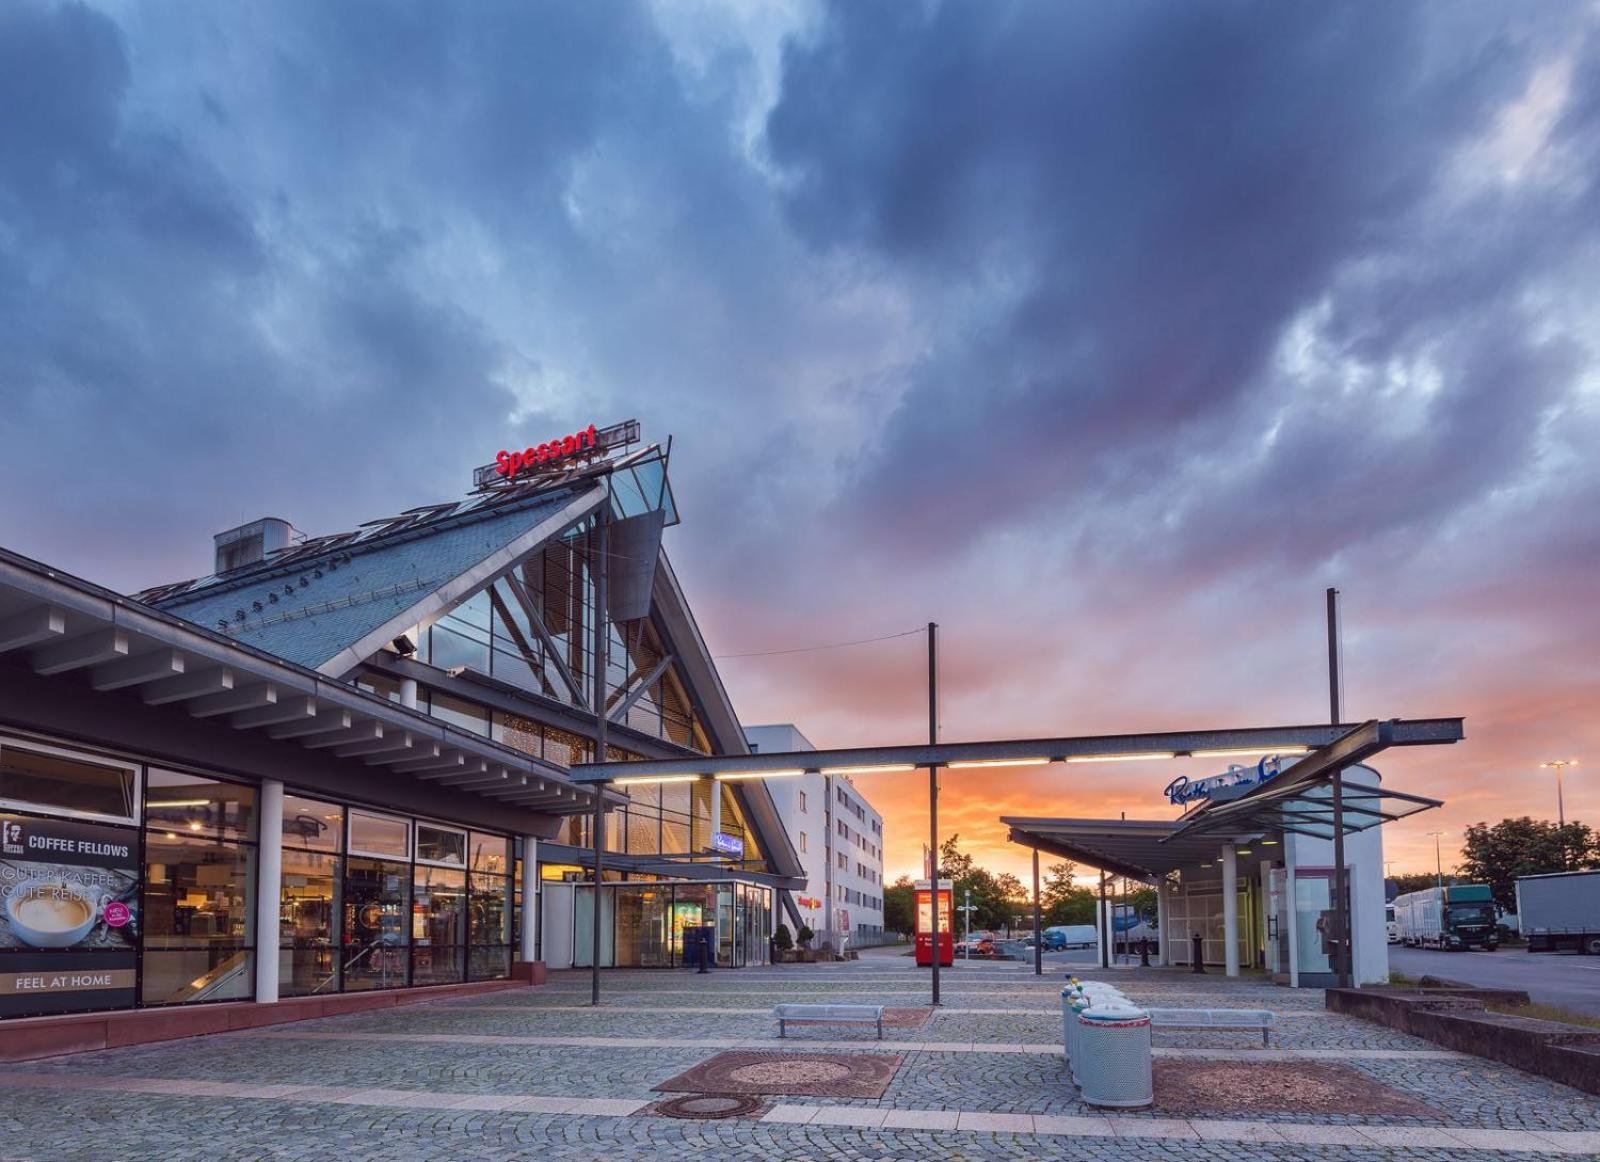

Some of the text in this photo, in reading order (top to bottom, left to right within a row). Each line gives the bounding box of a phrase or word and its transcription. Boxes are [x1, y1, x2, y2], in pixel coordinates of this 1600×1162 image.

[496, 423, 597, 481] Spessart
[28, 835, 75, 852] COFFEE
[78, 841, 129, 858] FELLOWS
[1, 867, 54, 882] GUTER
[1, 885, 46, 898] GUTE
[16, 975, 112, 989] FEEL AT HOME
